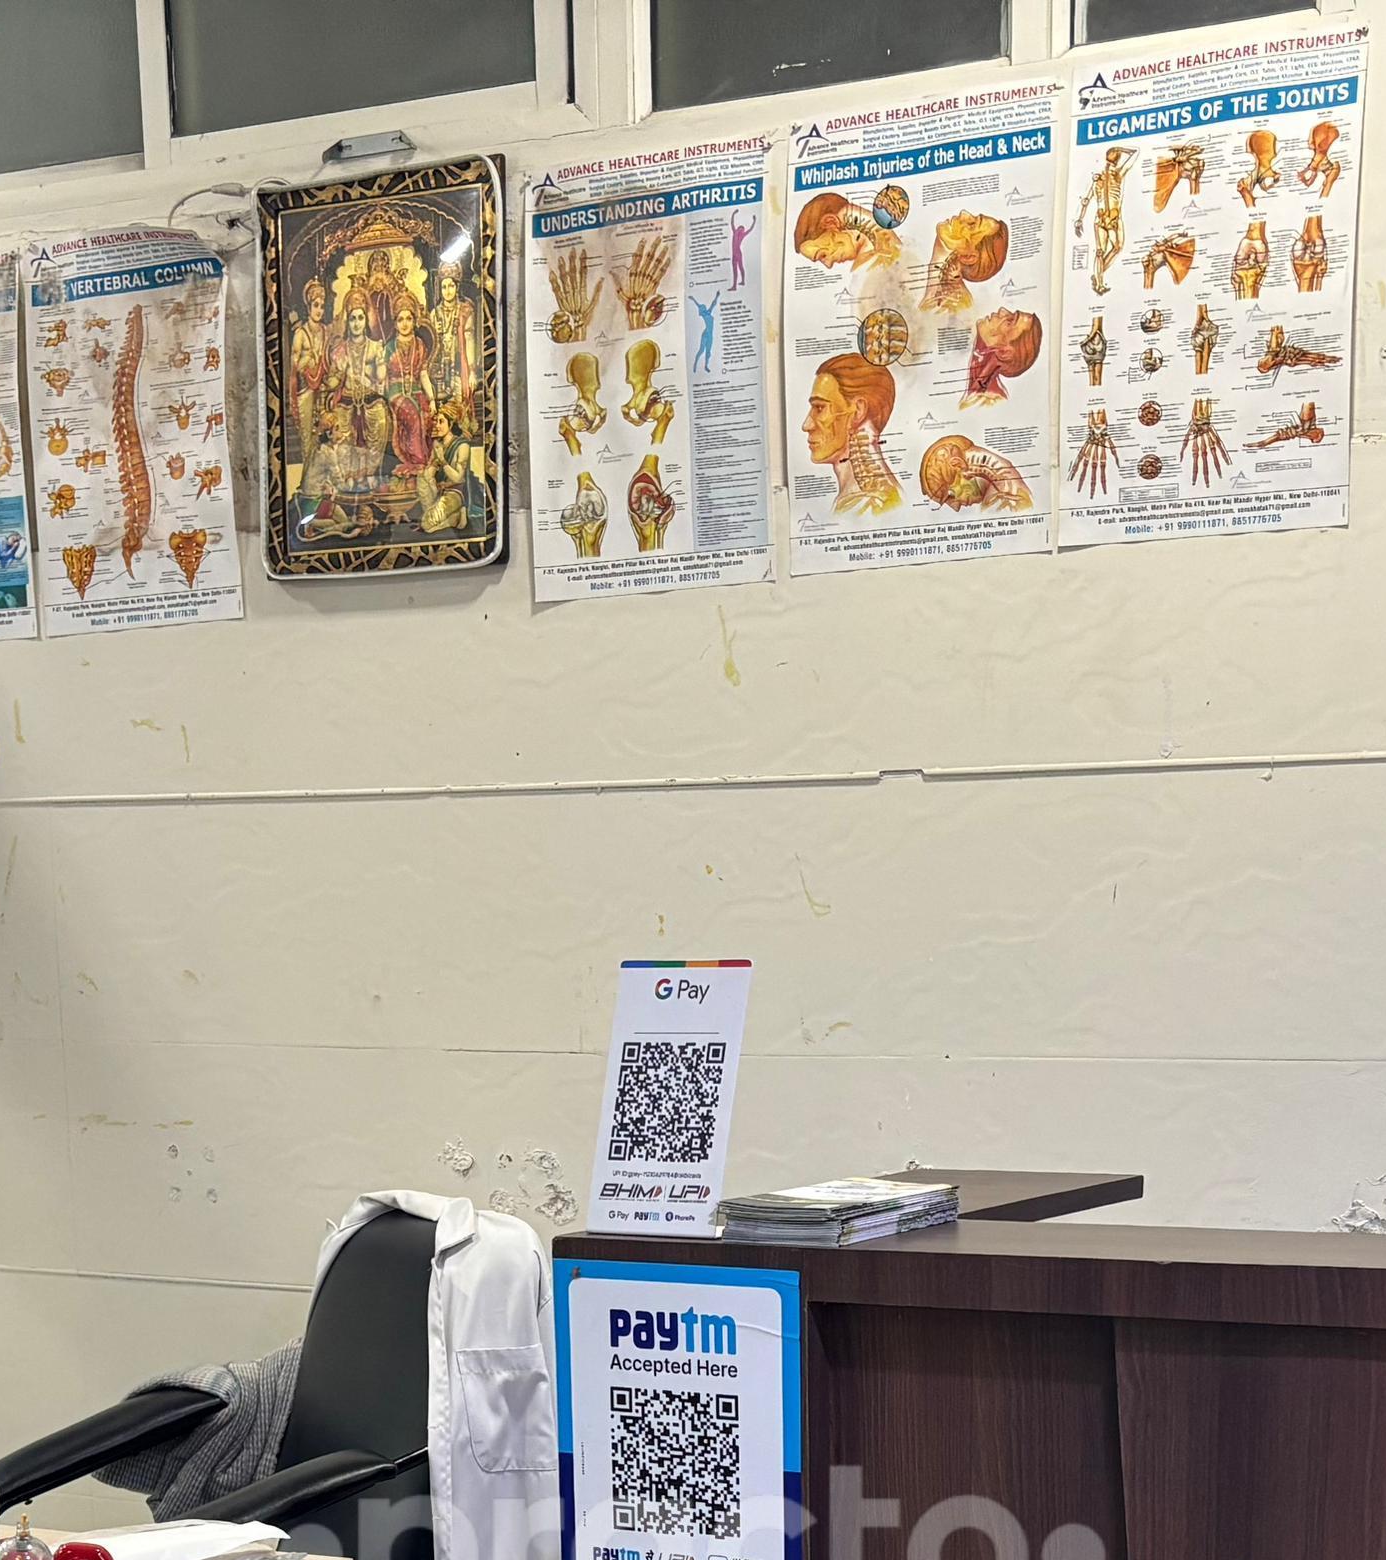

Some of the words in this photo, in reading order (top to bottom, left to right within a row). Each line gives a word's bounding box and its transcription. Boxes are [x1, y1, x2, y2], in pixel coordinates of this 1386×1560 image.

[1112, 60, 1171, 81] ADVANCE
[1176, 44, 1257, 69] HEALTHCARE
[1265, 29, 1361, 53] INSTRUMENTS
[825, 111, 880, 131] ADVANCE
[885, 97, 959, 121] HEALTHCARE
[965, 83, 1053, 107] INSTRUMENTS
[1087, 106, 1192, 140] LIGAMENTS
[1199, 100, 1223, 120] OF
[1231, 94, 1269, 115] THE
[1275, 83, 1349, 110] JOINTS
[557, 160, 604, 180] ADVANCE
[609, 149, 679, 170] HEALTHCARE
[684, 135, 764, 158] INSTRUMENTS
[801, 162, 858, 185] Whiplash
[863, 155, 913, 176] Injuries
[917, 150, 931, 168] of
[934, 148, 955, 165] the
[959, 140, 993, 160] Head
[997, 138, 1008, 155] &
[1013, 131, 1045, 153] Neck
[541, 198, 665, 233] UNDERSTANDING
[672, 183, 757, 210] ARTHRITIS
[52, 239, 87, 255] ADVANCE
[91, 232, 143, 248] HEALTHCARE
[70, 272, 149, 296] VERTEBRAL
[155, 261, 213, 284] COLUMN
[1125, 524, 1153, 534] Mobile:
[655, 978, 673, 1000] G
[677, 980, 710, 1004] Pay
[599, 1183, 657, 1198] BHIM
[668, 1184, 705, 1199] UPI
[617, 1211, 629, 1220] Pay
[610, 1354, 691, 1376] Accepted
[697, 1358, 738, 1378] Here
